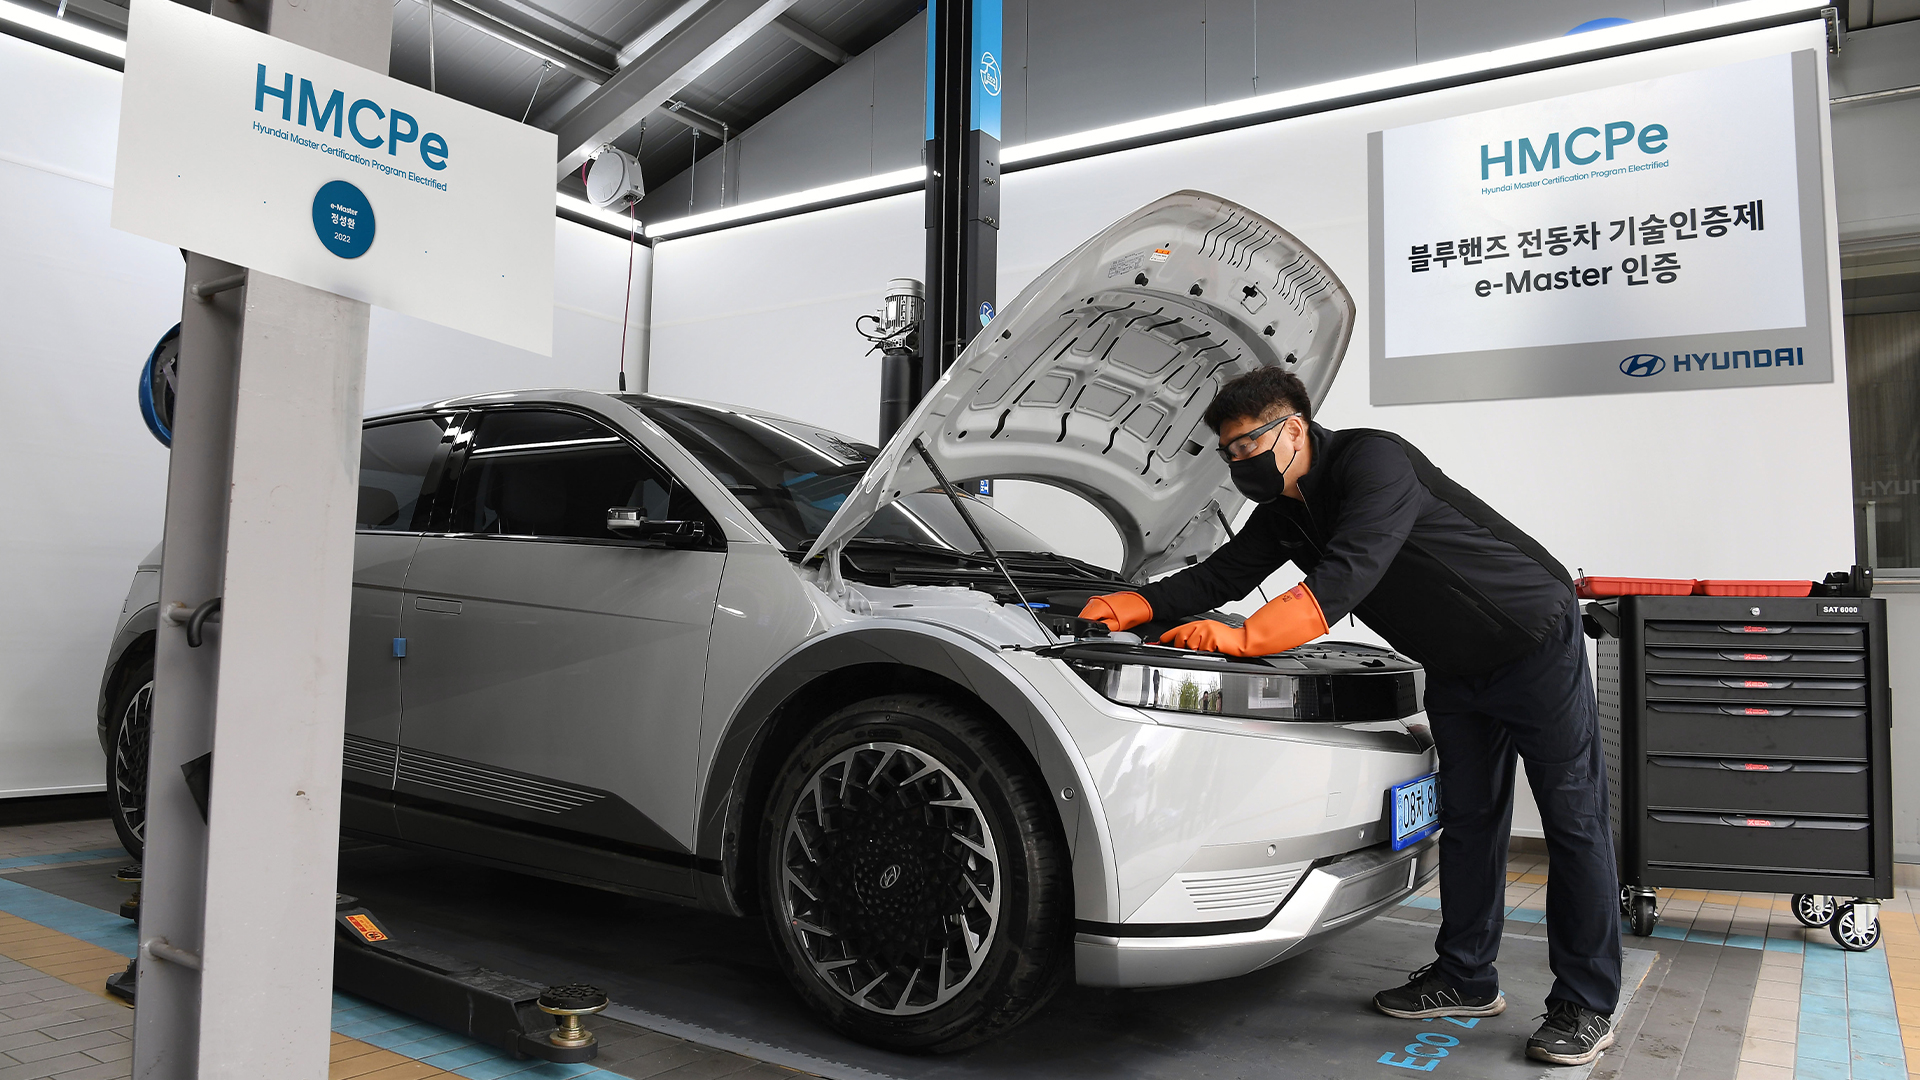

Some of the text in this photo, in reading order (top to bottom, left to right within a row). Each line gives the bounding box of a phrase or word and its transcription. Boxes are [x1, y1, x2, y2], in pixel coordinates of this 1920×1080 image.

[254, 63, 449, 171] HMCPe
[252, 120, 447, 192] Hyundai Master Certification Program Electrified
[1480, 120, 1669, 181] HMCPe
[1481, 159, 1669, 196] Hyundai Master Certification Program Electrified
[330, 202, 358, 216] e-Master
[331, 212, 355, 230] 정성환
[334, 231, 351, 244] 2022
[1408, 199, 1765, 273] 블루핸즈 전동차 기술인증제
[1474, 251, 1682, 298] e-Master 인증
[1673, 346, 1804, 373] HYUNDAI
[1403, 785, 1424, 829] 08차
[1427, 782, 1439, 817] 82
